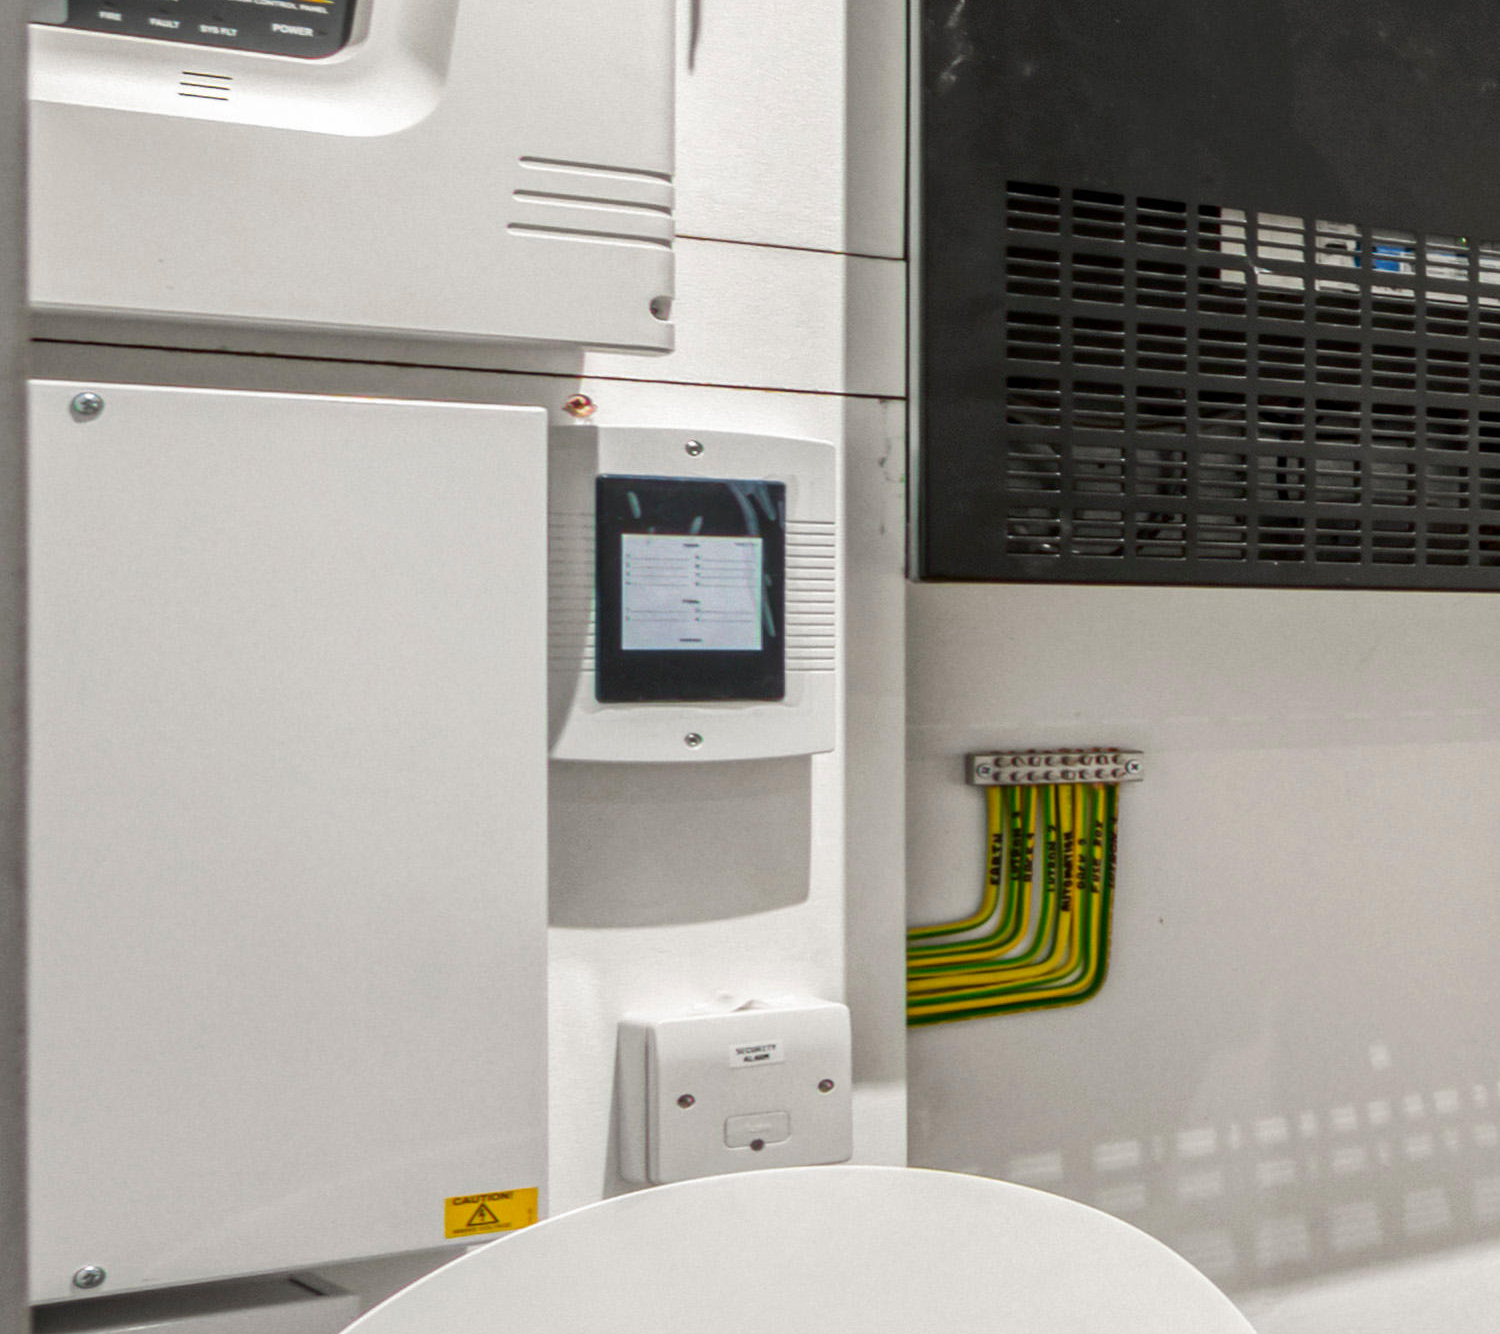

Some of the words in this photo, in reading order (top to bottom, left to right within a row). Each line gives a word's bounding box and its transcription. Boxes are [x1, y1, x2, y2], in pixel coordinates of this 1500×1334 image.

[98, 10, 123, 22] FIRE
[149, 17, 181, 29] FAULT
[271, 22, 315, 38] POWER
[735, 1044, 777, 1055] SECURITY
[743, 1053, 770, 1062] ALARM
